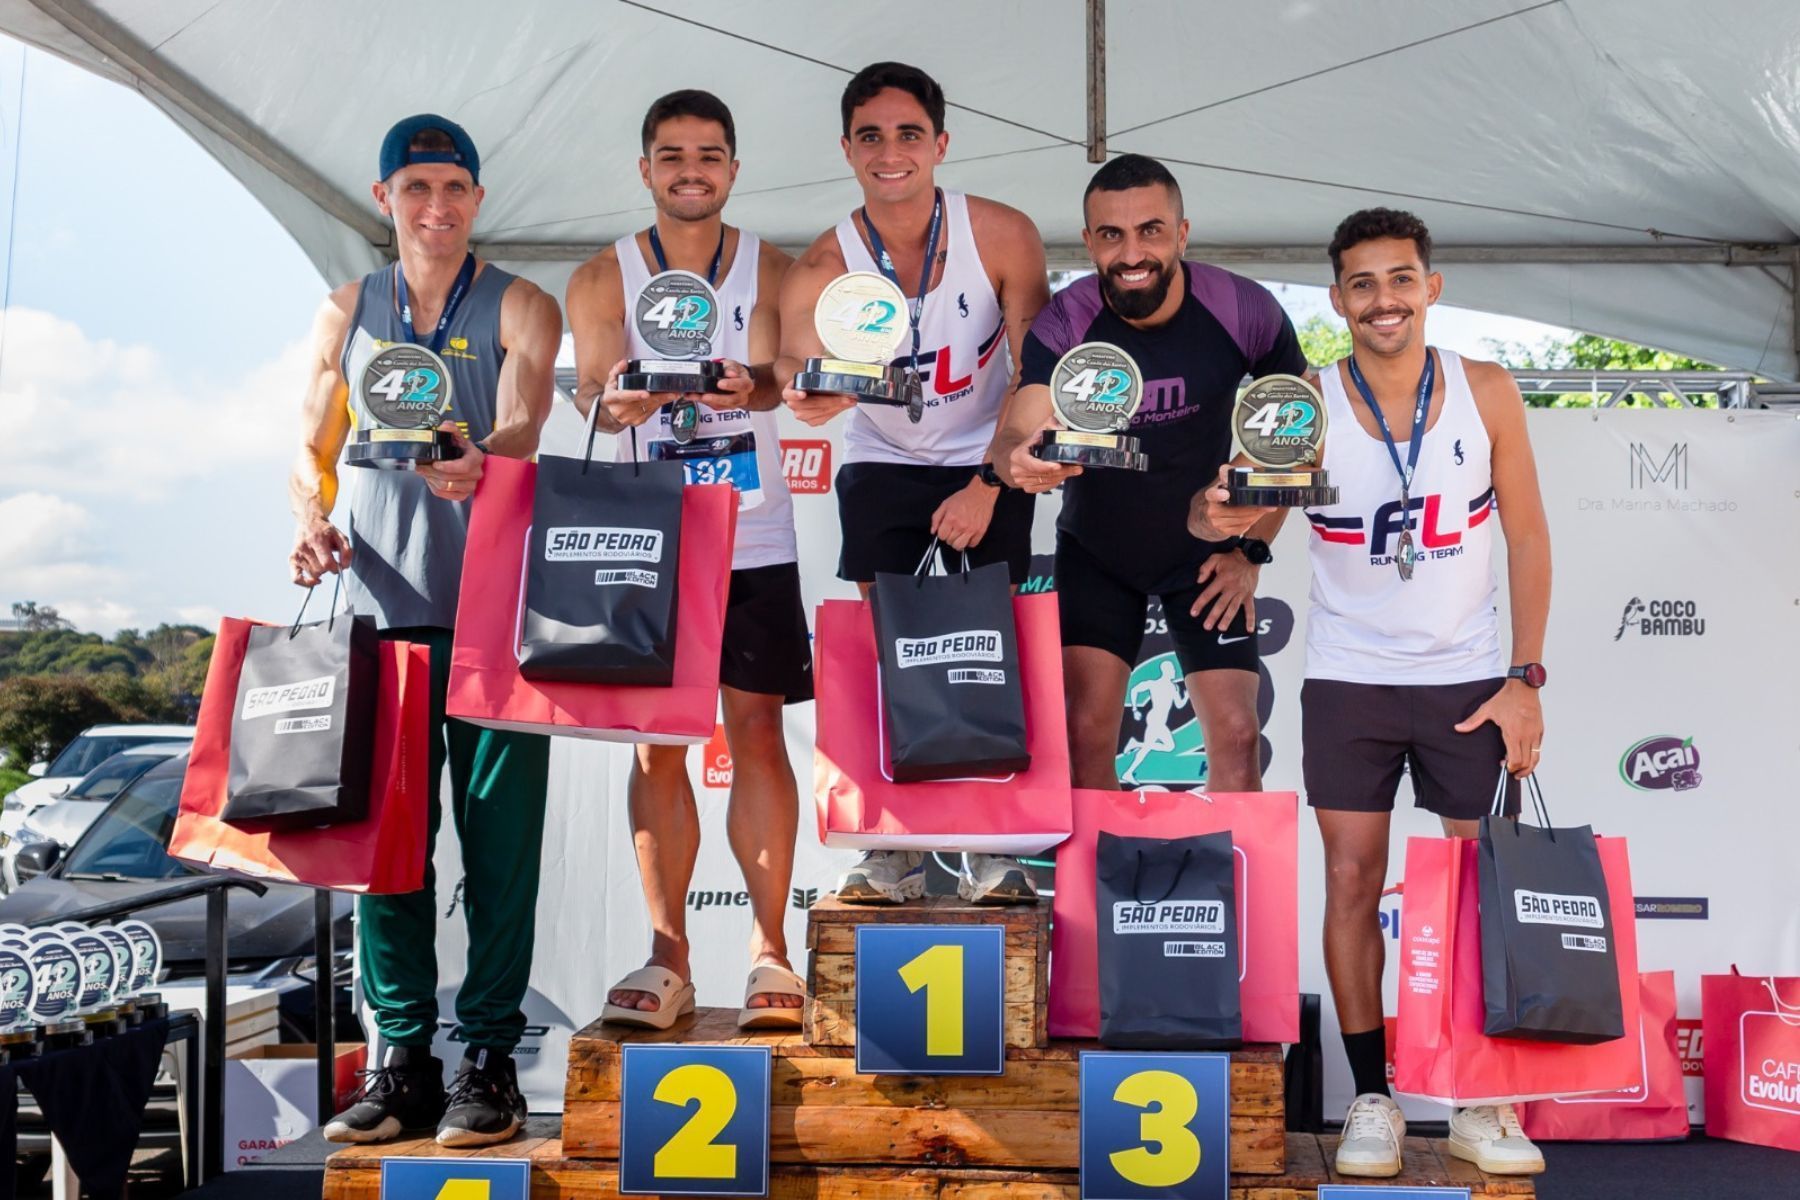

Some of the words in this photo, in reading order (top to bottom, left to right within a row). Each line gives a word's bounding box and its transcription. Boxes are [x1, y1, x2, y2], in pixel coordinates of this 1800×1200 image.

[642, 295, 711, 330] 42
[669, 330, 705, 339] ANOS
[369, 368, 440, 402] 42
[943, 385, 974, 403] TEAM
[1062, 368, 1132, 404] 42
[396, 402, 434, 411] ANOS
[716, 410, 751, 422] TEAM
[1087, 403, 1124, 413] ANOS
[1244, 400, 1316, 436] 42
[1272, 437, 1310, 446] ANOS
[781, 448, 823, 477] RO
[1370, 494, 1462, 555] FL
[552, 530, 591, 550] SÃO
[593, 533, 657, 551] PEDRO
[1370, 552, 1425, 566] RUNG
[1430, 546, 1463, 560] TEAM
[1650, 600, 1696, 617] COCO
[1641, 618, 1705, 636] BAMBU
[902, 641, 937, 658] SÃO
[941, 636, 997, 653] PEDRO
[279, 682, 330, 703] PEDRO
[1160, 906, 1219, 923] PEDRO
[1521, 894, 1550, 913] SÃO
[1552, 899, 1597, 917] PEDRO
[1, 1000, 25, 1009] NOS
[46, 990, 73, 1001] ANOS
[898, 944, 964, 1057] 1
[1762, 1058, 1800, 1081] CAF
[653, 1064, 737, 1178] 2
[1108, 1070, 1201, 1187] 3
